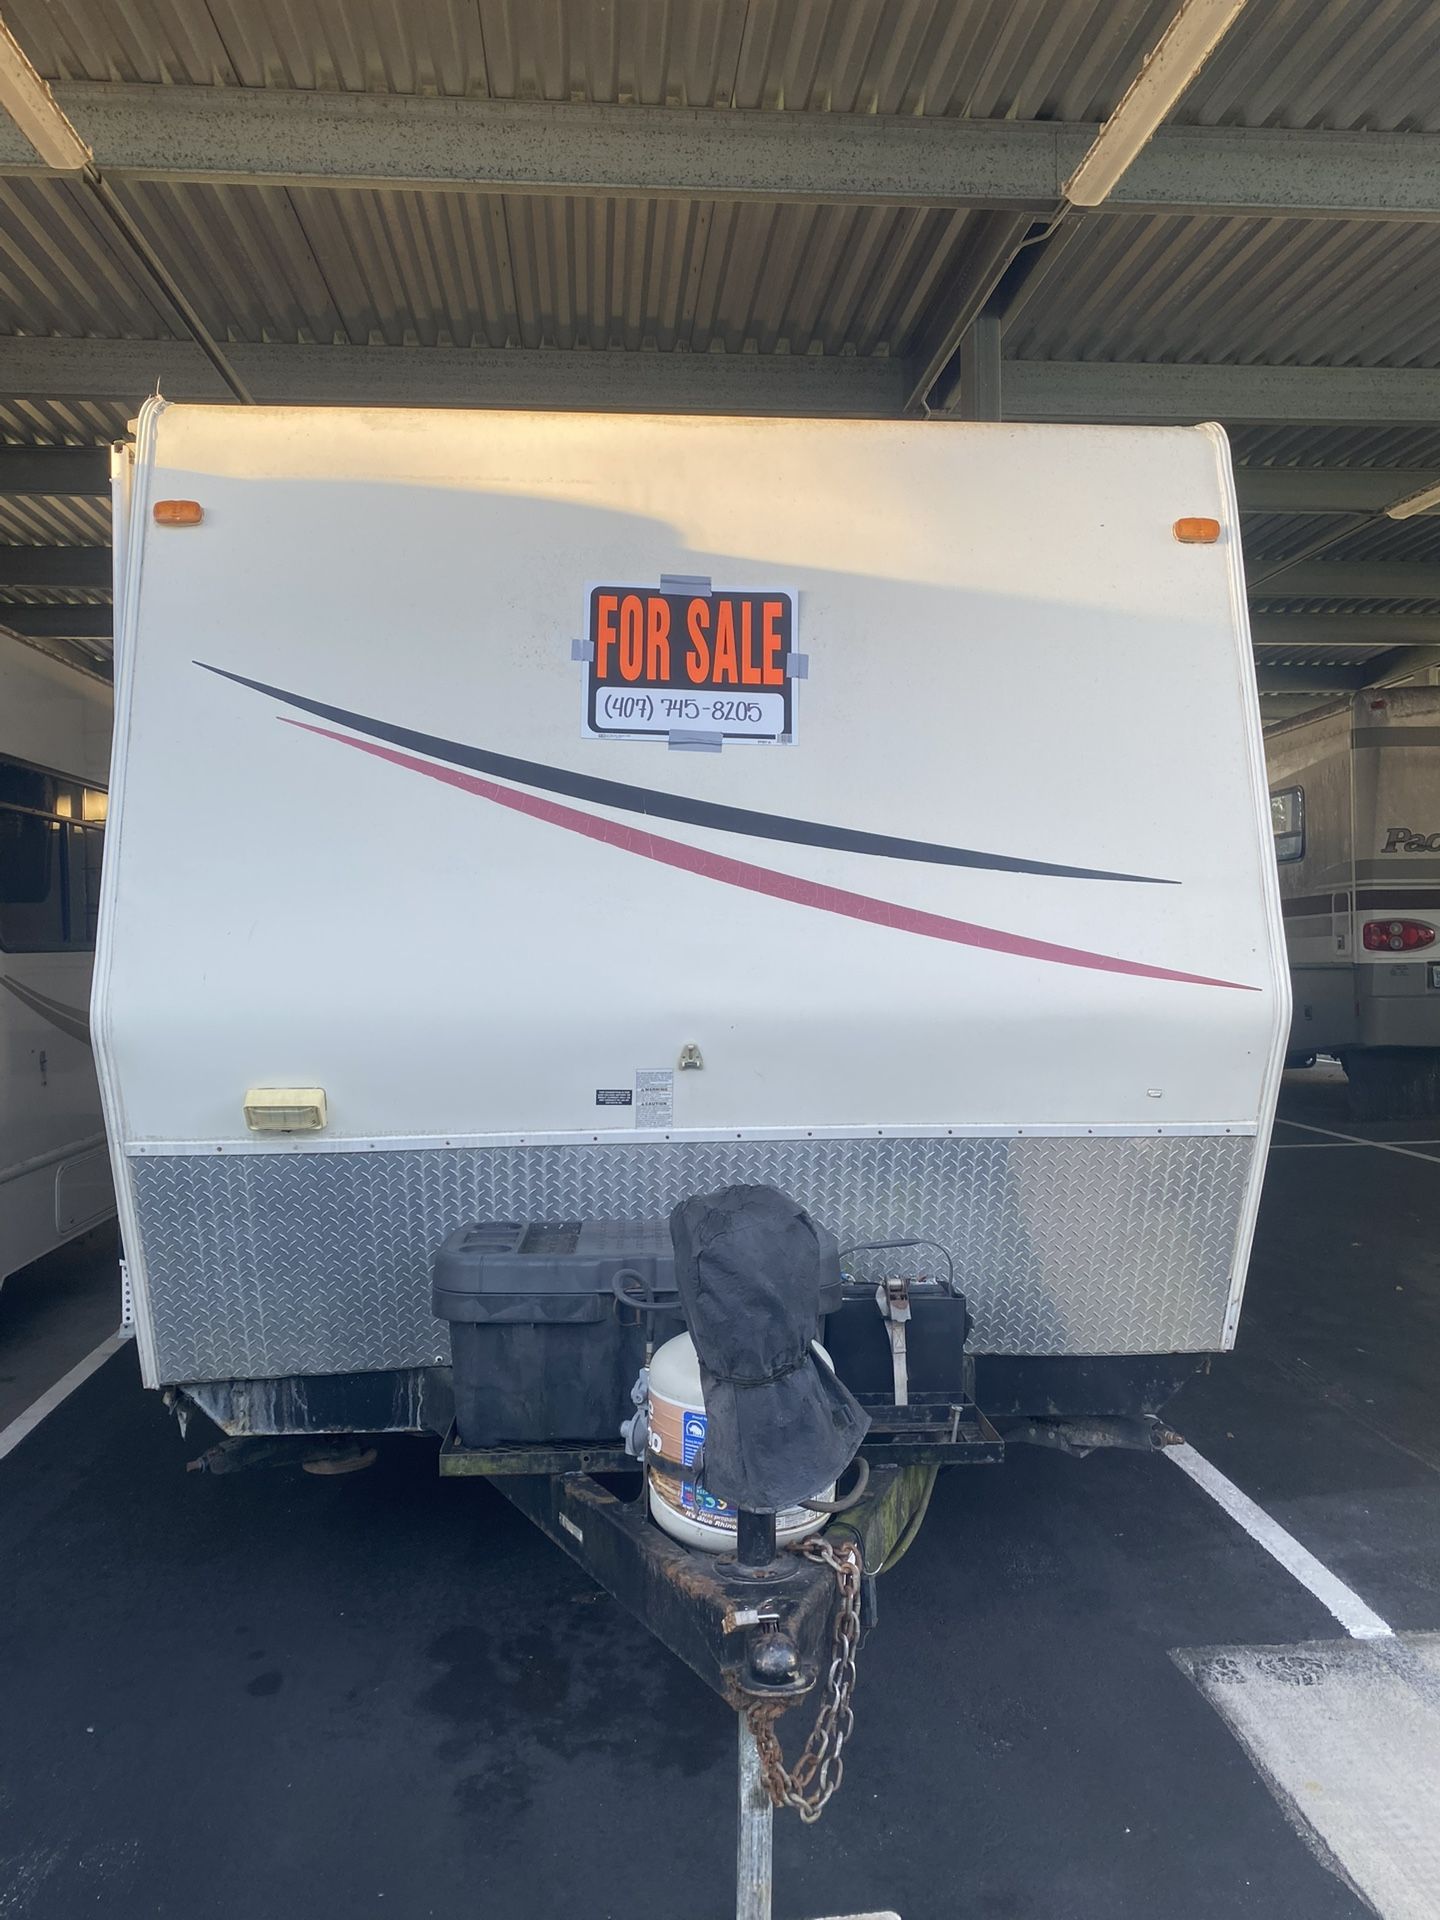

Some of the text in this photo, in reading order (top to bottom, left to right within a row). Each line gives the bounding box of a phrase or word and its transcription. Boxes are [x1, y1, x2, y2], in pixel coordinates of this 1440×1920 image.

[596, 594, 784, 685] FOR SALE
[604, 694, 763, 722] (407) 745-8205
